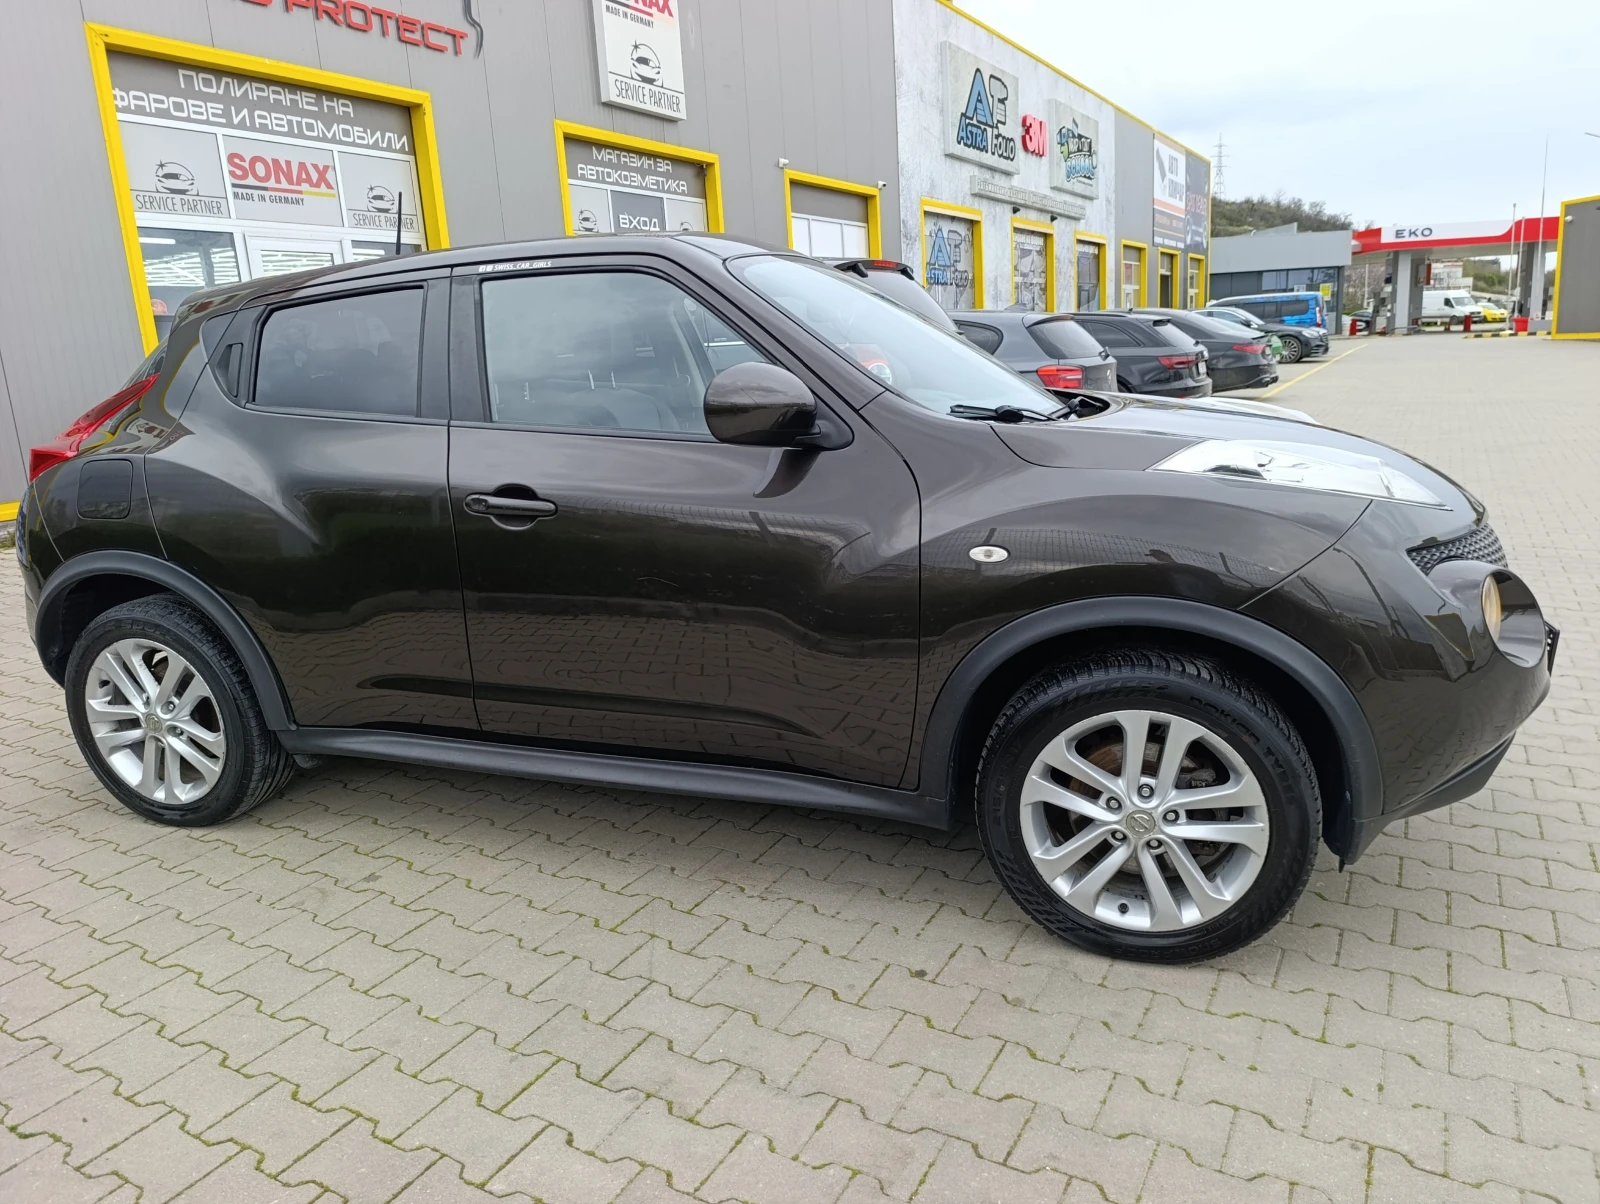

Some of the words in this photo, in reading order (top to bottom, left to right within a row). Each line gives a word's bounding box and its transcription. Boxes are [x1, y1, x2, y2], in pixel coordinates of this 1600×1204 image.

[605, 4, 620, 17] MADE
[622, 10, 628, 20] IN
[630, 13, 654, 29] GERMANY
[178, 69, 318, 111] ПОЛИРАНЕ
[322, 95, 354, 118] НА
[615, 79, 647, 105] SERVICE
[648, 88, 681, 113] PARTNER
[112, 87, 226, 123] ФАРОВЕ
[231, 105, 250, 127] И
[254, 110, 408, 152] АВТОМОБИЛИ
[957, 112, 988, 153] ASTRA
[991, 126, 1016, 161] FOLIO
[1021, 114, 1047, 157] 3M
[227, 152, 334, 190] SONAX
[592, 146, 654, 170] МАГАЗИН
[656, 159, 672, 173] ЗА
[1066, 154, 1095, 182] SCHOOL
[577, 163, 687, 194] АВТОКОЗМЕТИКА
[135, 194, 177, 212] SERVICE
[181, 197, 223, 215] PARTNER
[233, 191, 255, 203] MADE
[258, 193, 266, 204] IN
[269, 195, 305, 206] GERMANY
[353, 213, 383, 228] SERVICE
[384, 215, 414, 230] PARNER
[619, 214, 660, 231] ВХОД
[1395, 227, 1433, 239] EKO
[493, 261, 552, 271] SWISS_CAR_GIRLS
